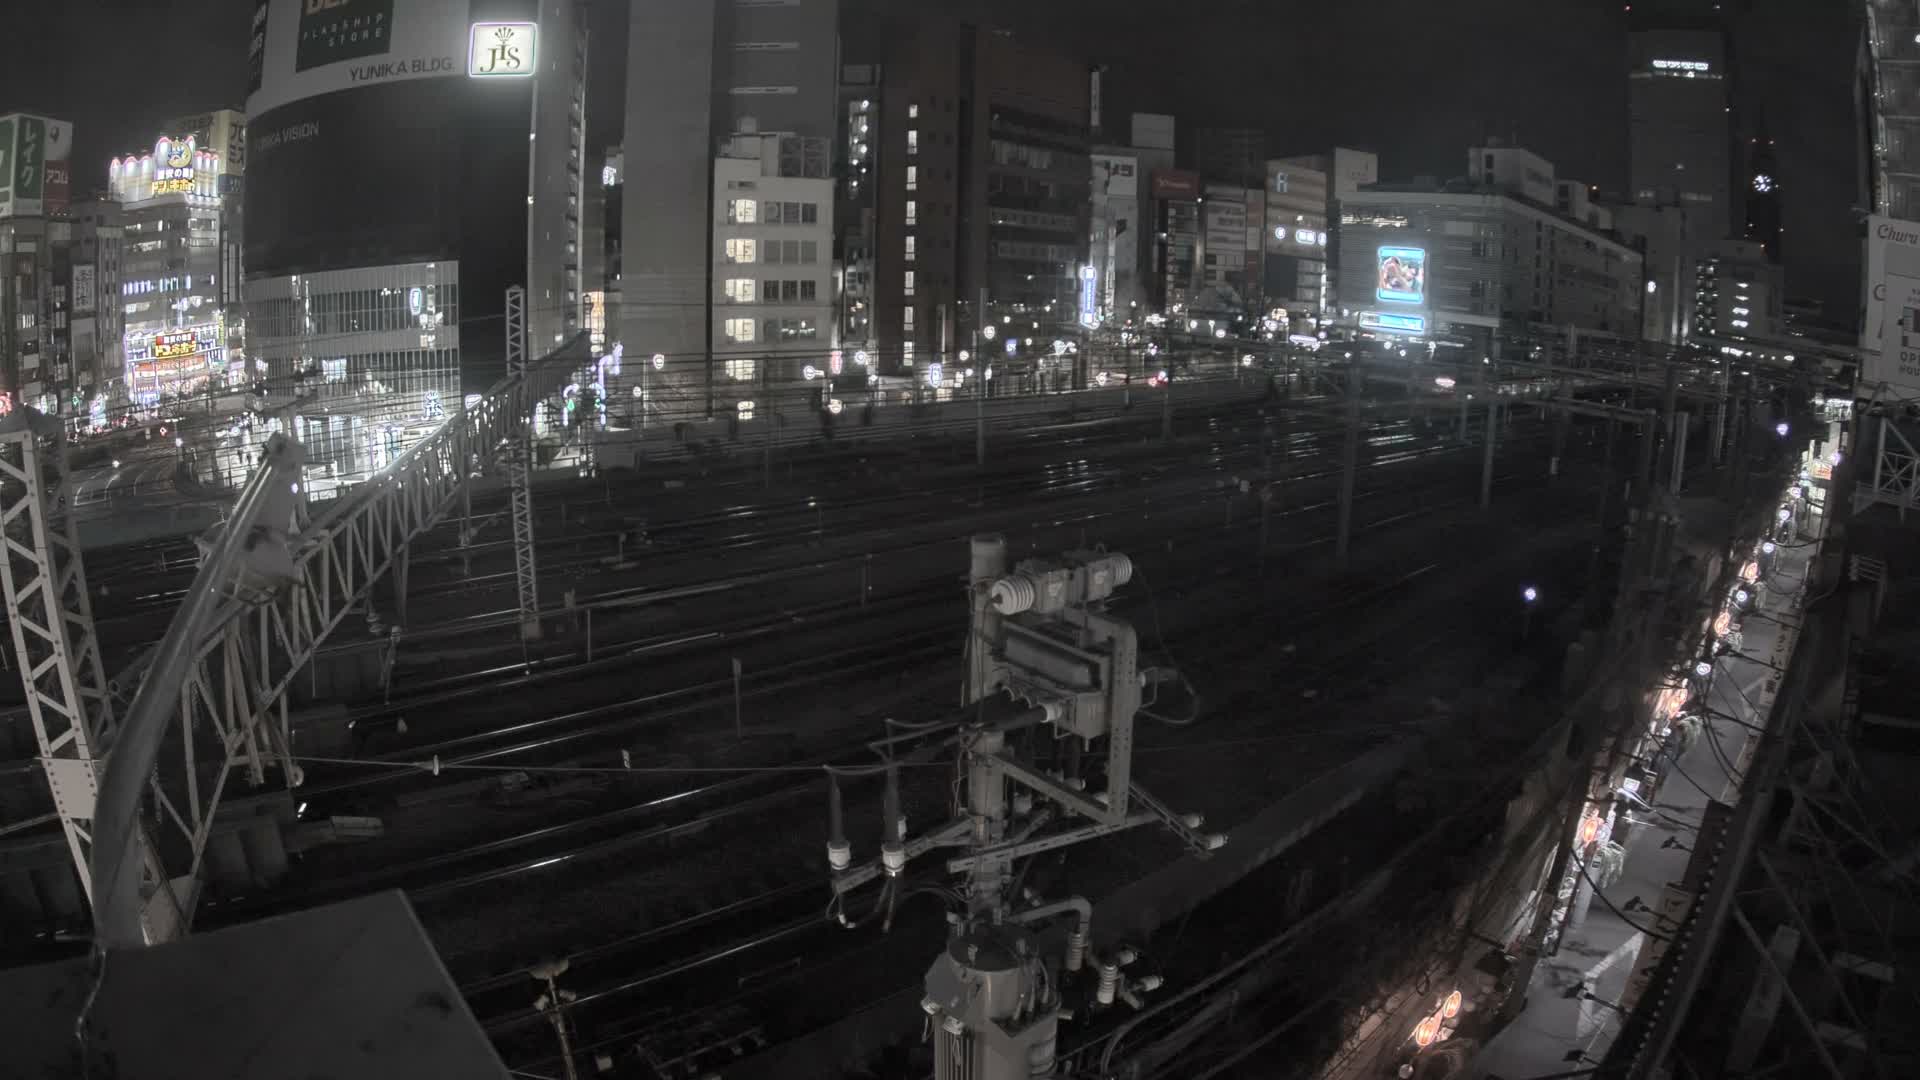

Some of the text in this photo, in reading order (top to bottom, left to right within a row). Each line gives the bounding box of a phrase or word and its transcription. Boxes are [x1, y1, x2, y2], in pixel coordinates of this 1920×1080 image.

[328, 27, 384, 48] STORE
[350, 62, 408, 81] YUNIKA
[281, 121, 320, 143] VISION
